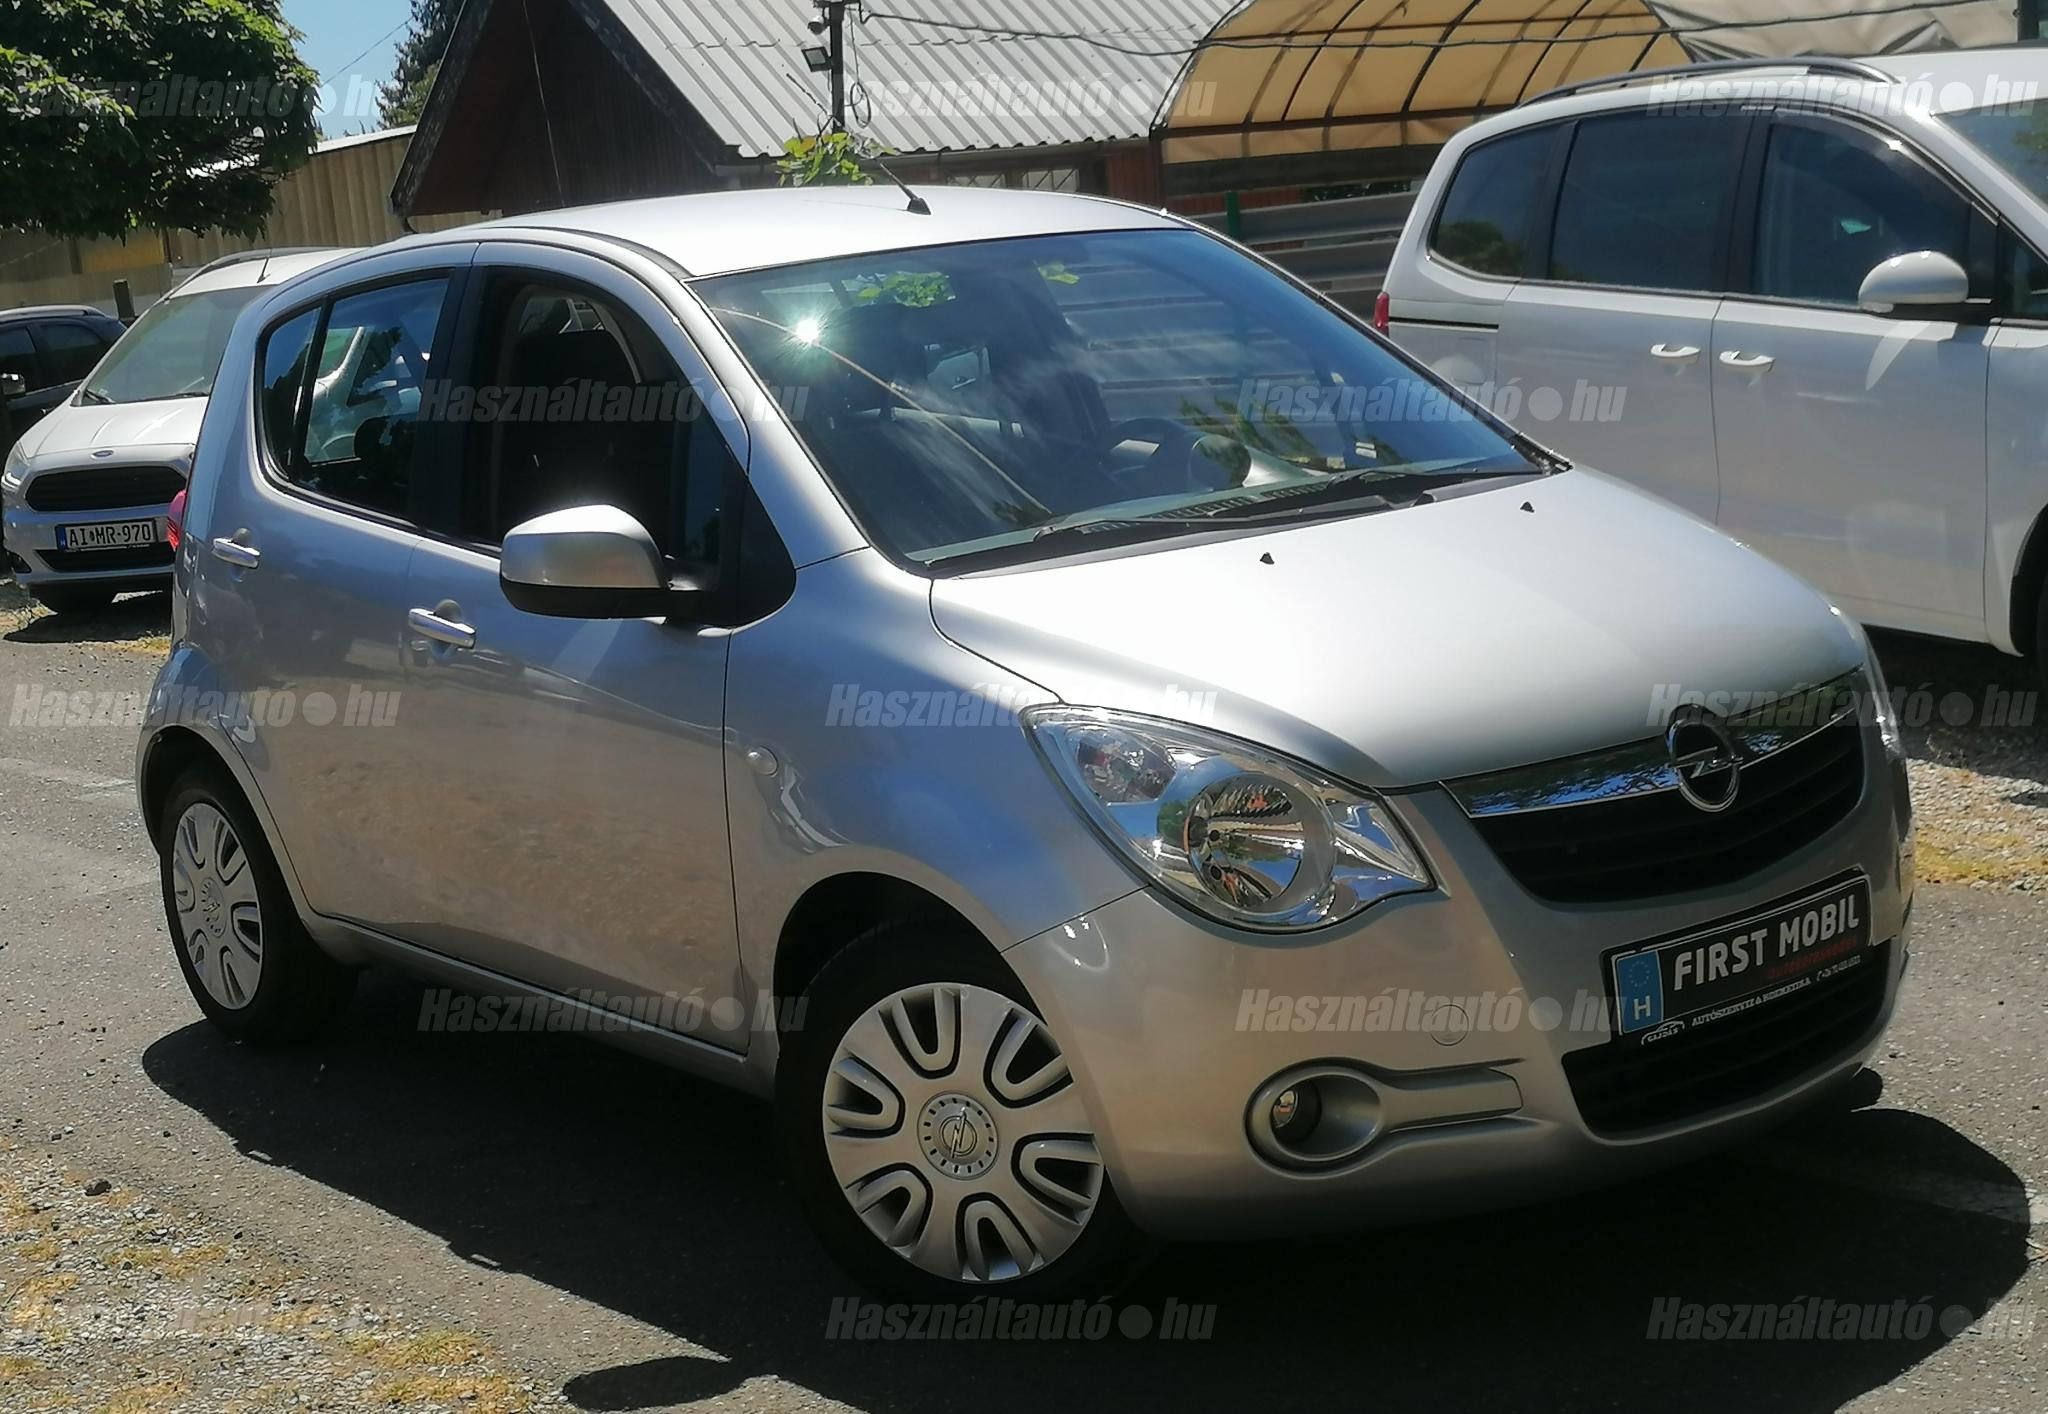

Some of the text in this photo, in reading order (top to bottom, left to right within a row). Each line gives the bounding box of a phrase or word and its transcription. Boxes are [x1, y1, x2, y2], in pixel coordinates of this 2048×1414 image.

[1673, 928, 1768, 992] FIRST
[1778, 894, 1860, 958] MOBIL
[1633, 995, 1651, 1020] H
